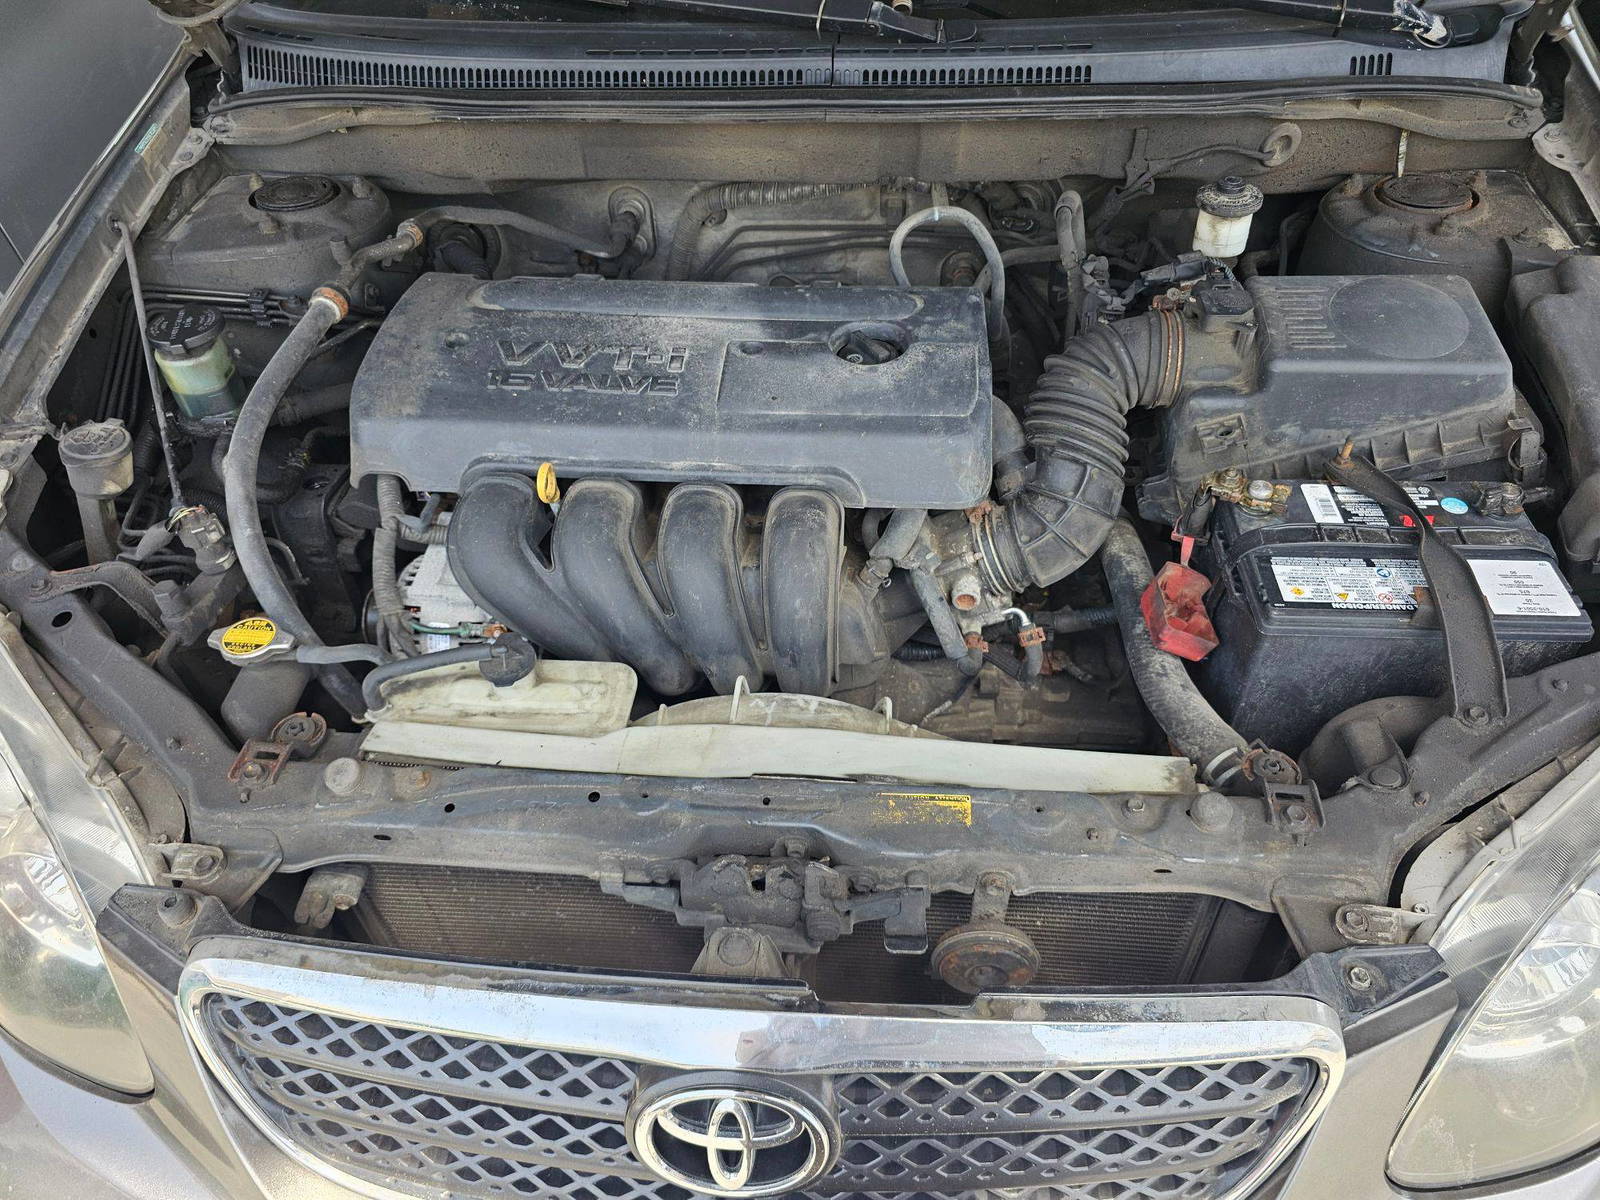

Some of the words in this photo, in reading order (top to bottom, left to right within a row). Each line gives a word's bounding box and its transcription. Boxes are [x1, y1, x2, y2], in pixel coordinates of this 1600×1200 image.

[496, 340, 688, 373] VVT-i
[540, 370, 680, 397] VALVE
[1331, 602, 1415, 611] DANGER/POISON
